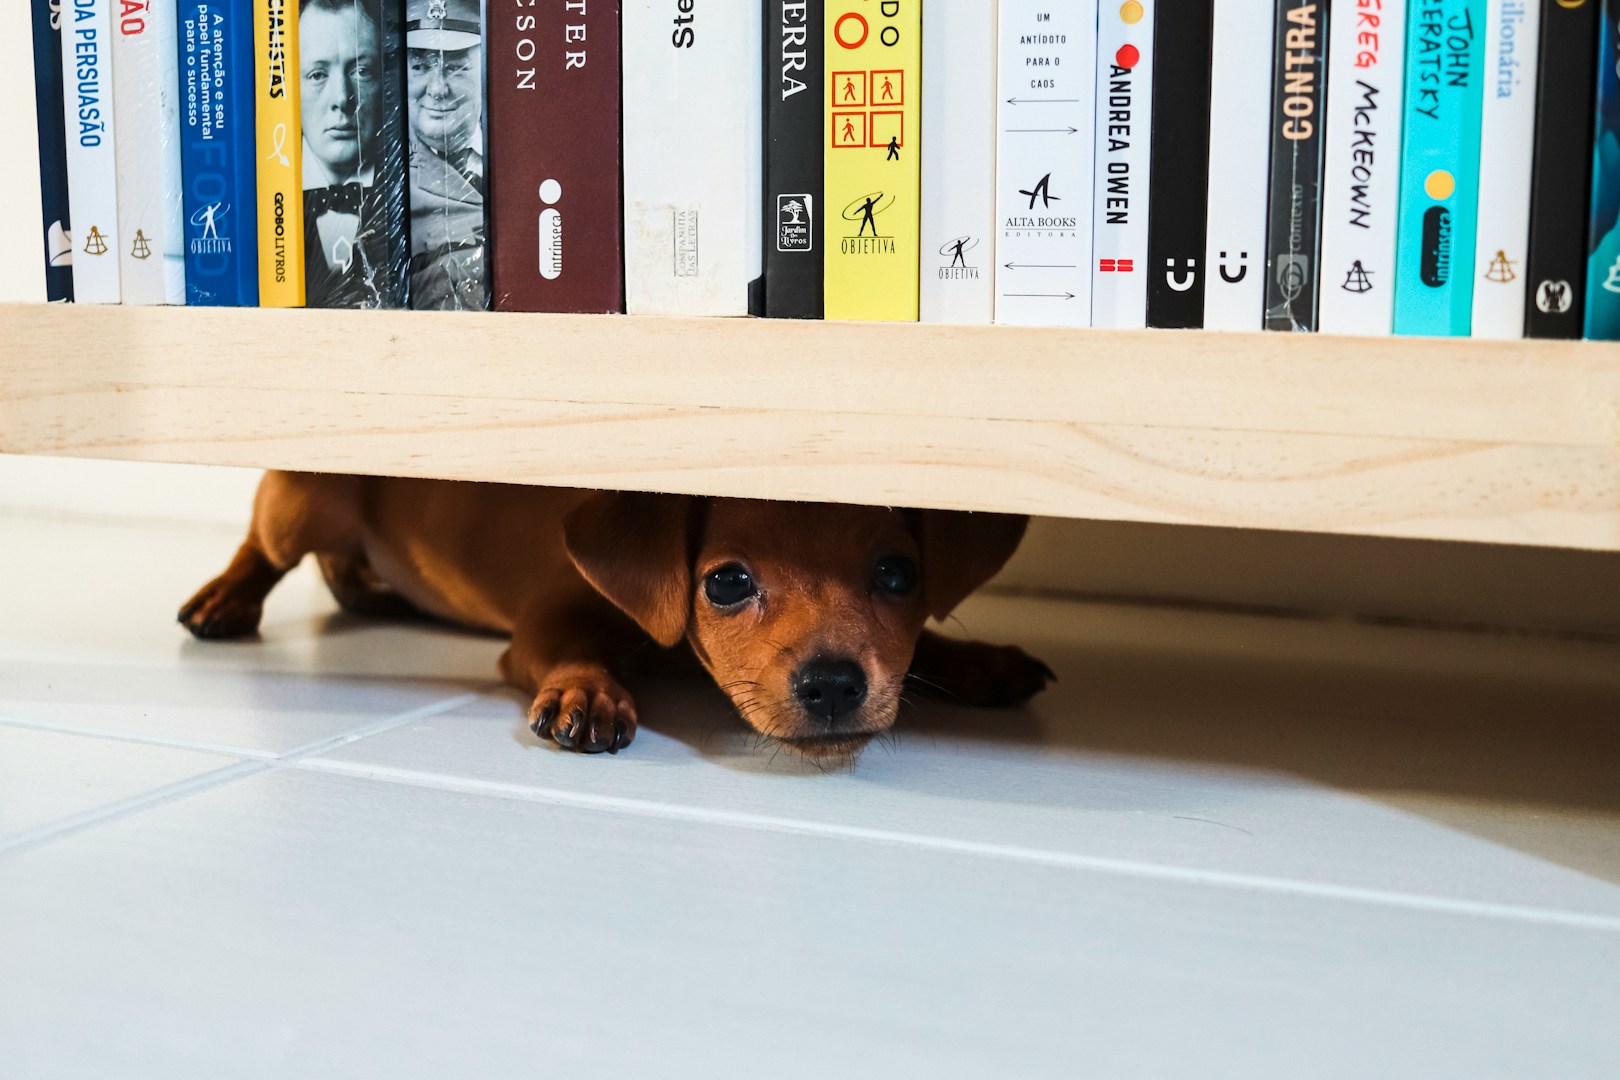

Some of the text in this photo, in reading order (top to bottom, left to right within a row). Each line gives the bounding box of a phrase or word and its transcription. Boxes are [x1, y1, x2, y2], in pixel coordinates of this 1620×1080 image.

[1037, 13, 1050, 22] UM
[1020, 33, 1067, 45] ANTÍDOTO
[1446, 7, 1474, 88] JOHN
[782, 1, 807, 101] ERRA
[1026, 57, 1060, 67] PARA O
[185, 20, 197, 126] para o sucesso
[198, 4, 213, 140] papel fundamental
[213, 14, 226, 129] A atenção e seu
[1282, 3, 1317, 141] CONTRA
[75, 29, 105, 147] PERSUASÃO
[1030, 79, 1055, 89] CAOS
[1106, 64, 1132, 225] ANDREA OWEN
[1005, 217, 1076, 227] ALTA BOOKS
[190, 240, 232, 254] OBJETIVA
[781, 236, 807, 247] Livros
[841, 238, 896, 255] OBJETIVA
[938, 268, 979, 280] OBJETIVA
